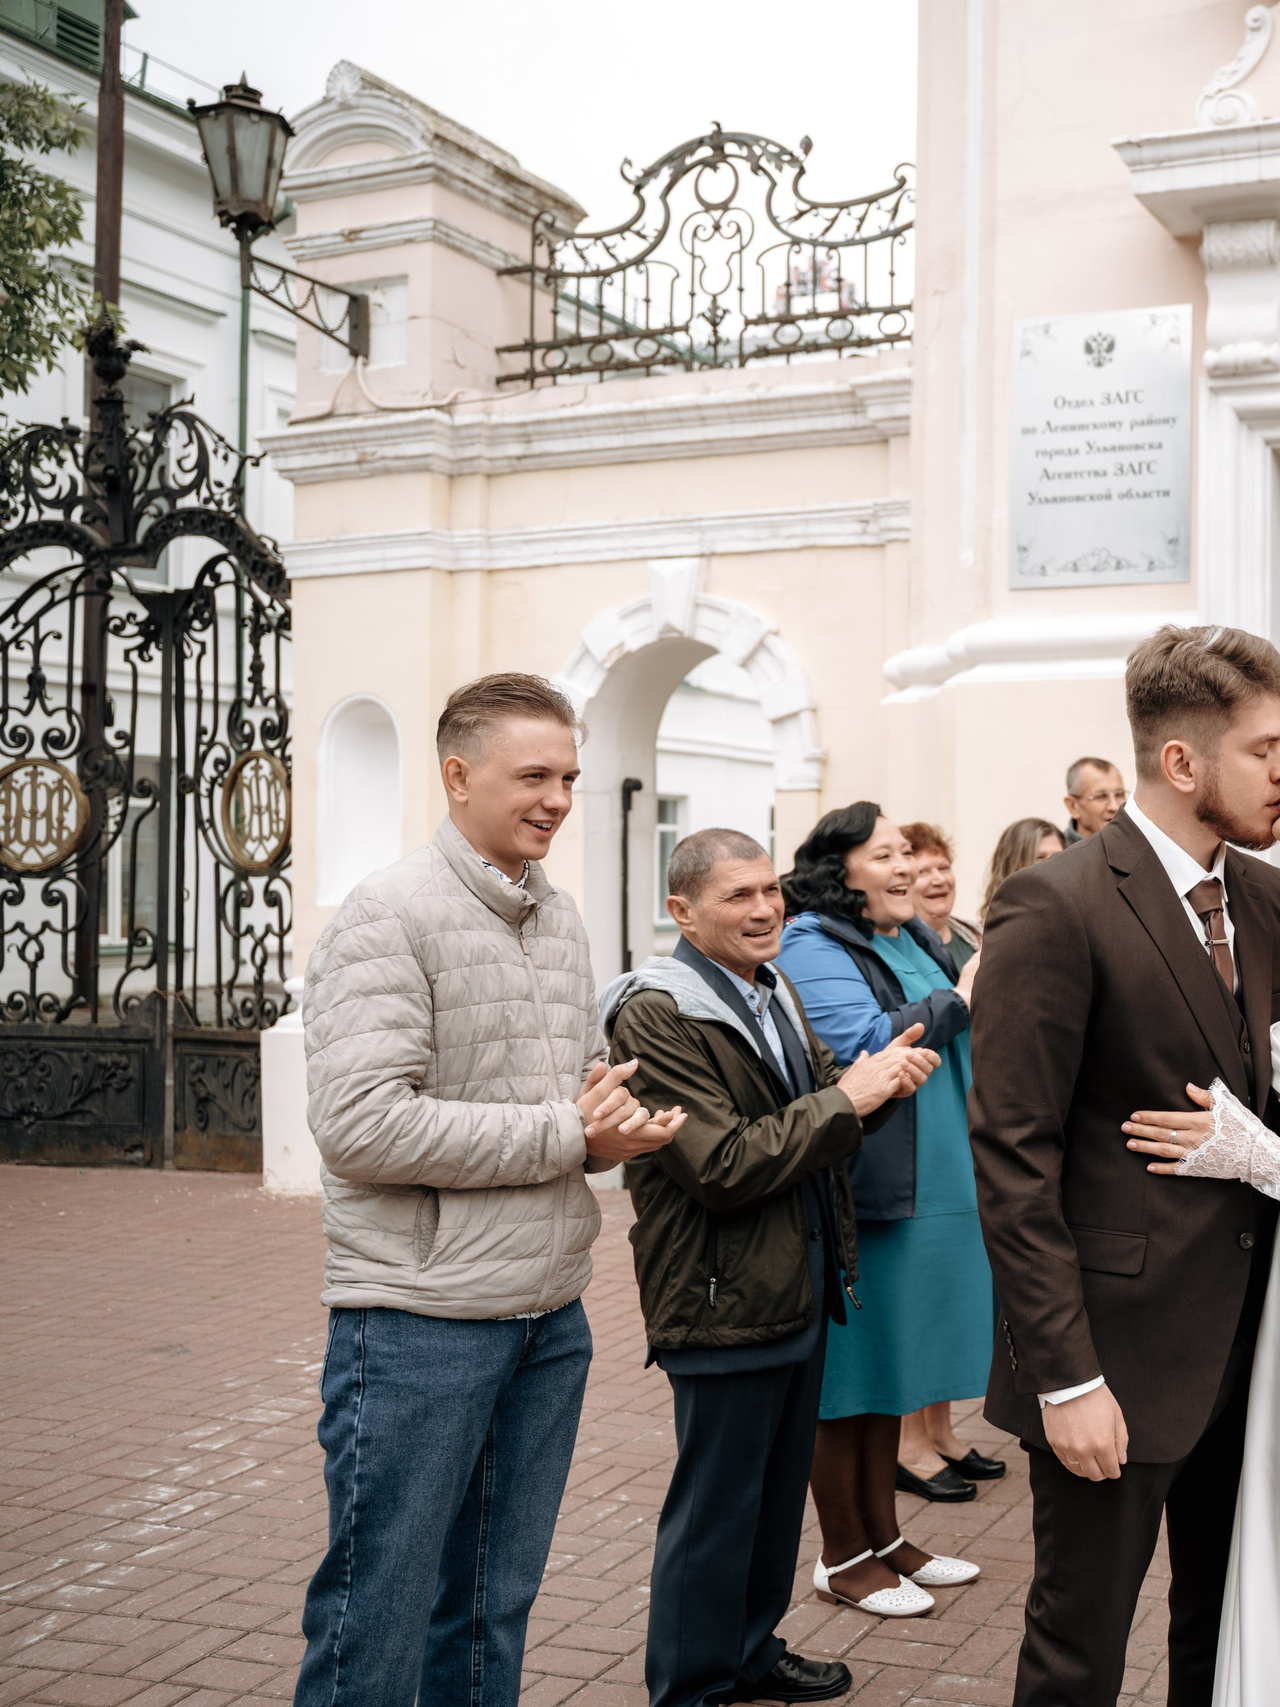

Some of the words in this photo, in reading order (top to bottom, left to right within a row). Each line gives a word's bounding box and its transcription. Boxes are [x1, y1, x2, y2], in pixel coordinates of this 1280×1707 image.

[1053, 394, 1095, 410] Отдел
[1100, 389, 1145, 407] ЗАГС
[1021, 426, 1037, 436] по
[1041, 420, 1123, 435] Ленинскому
[1129, 413, 1178, 431] району
[1035, 447, 1080, 460] города
[1085, 440, 1163, 455] Ульяновска
[1039, 467, 1107, 482] Агентства
[1113, 460, 1157, 477] ЗАГС
[1027, 488, 1112, 506] Ульяновской
[1117, 487, 1171, 501] области
